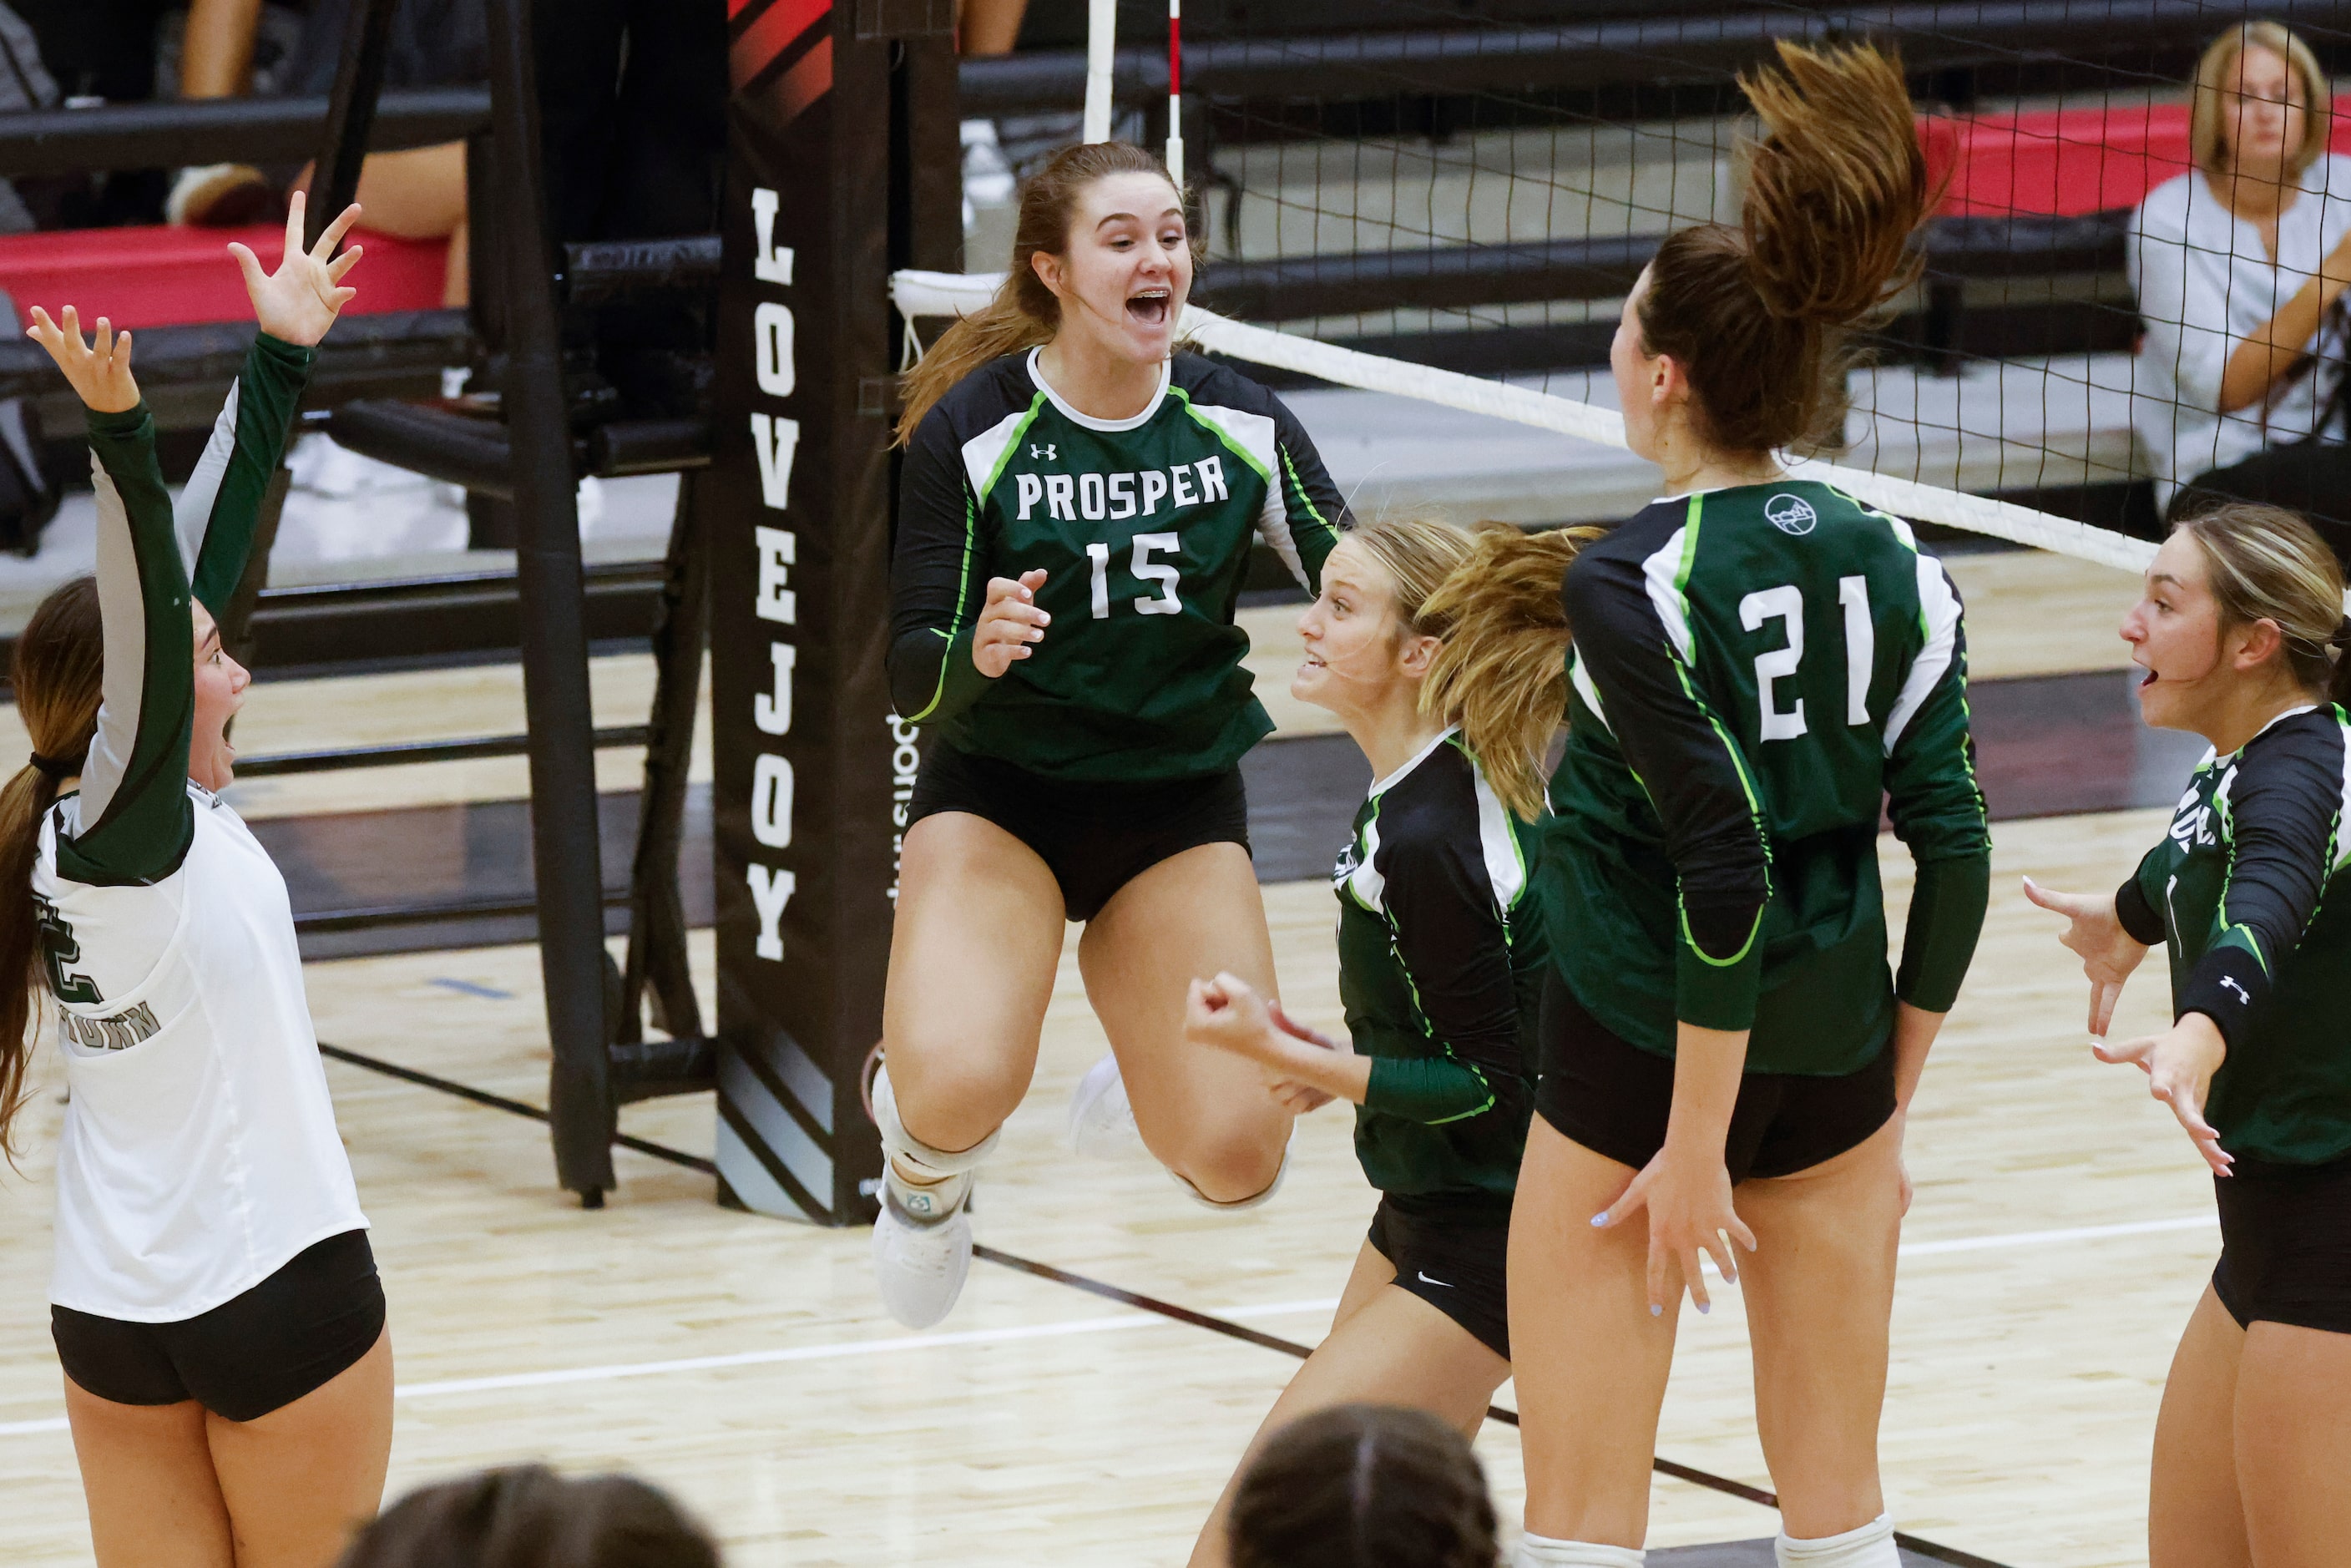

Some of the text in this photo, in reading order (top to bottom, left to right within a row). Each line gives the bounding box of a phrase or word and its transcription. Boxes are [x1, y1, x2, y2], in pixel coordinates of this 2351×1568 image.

[1015, 455, 1229, 521] PROSPER
[746, 187, 799, 962] LOVEJOY
[1085, 531, 1183, 620] 15
[1738, 574, 1874, 743] 21
